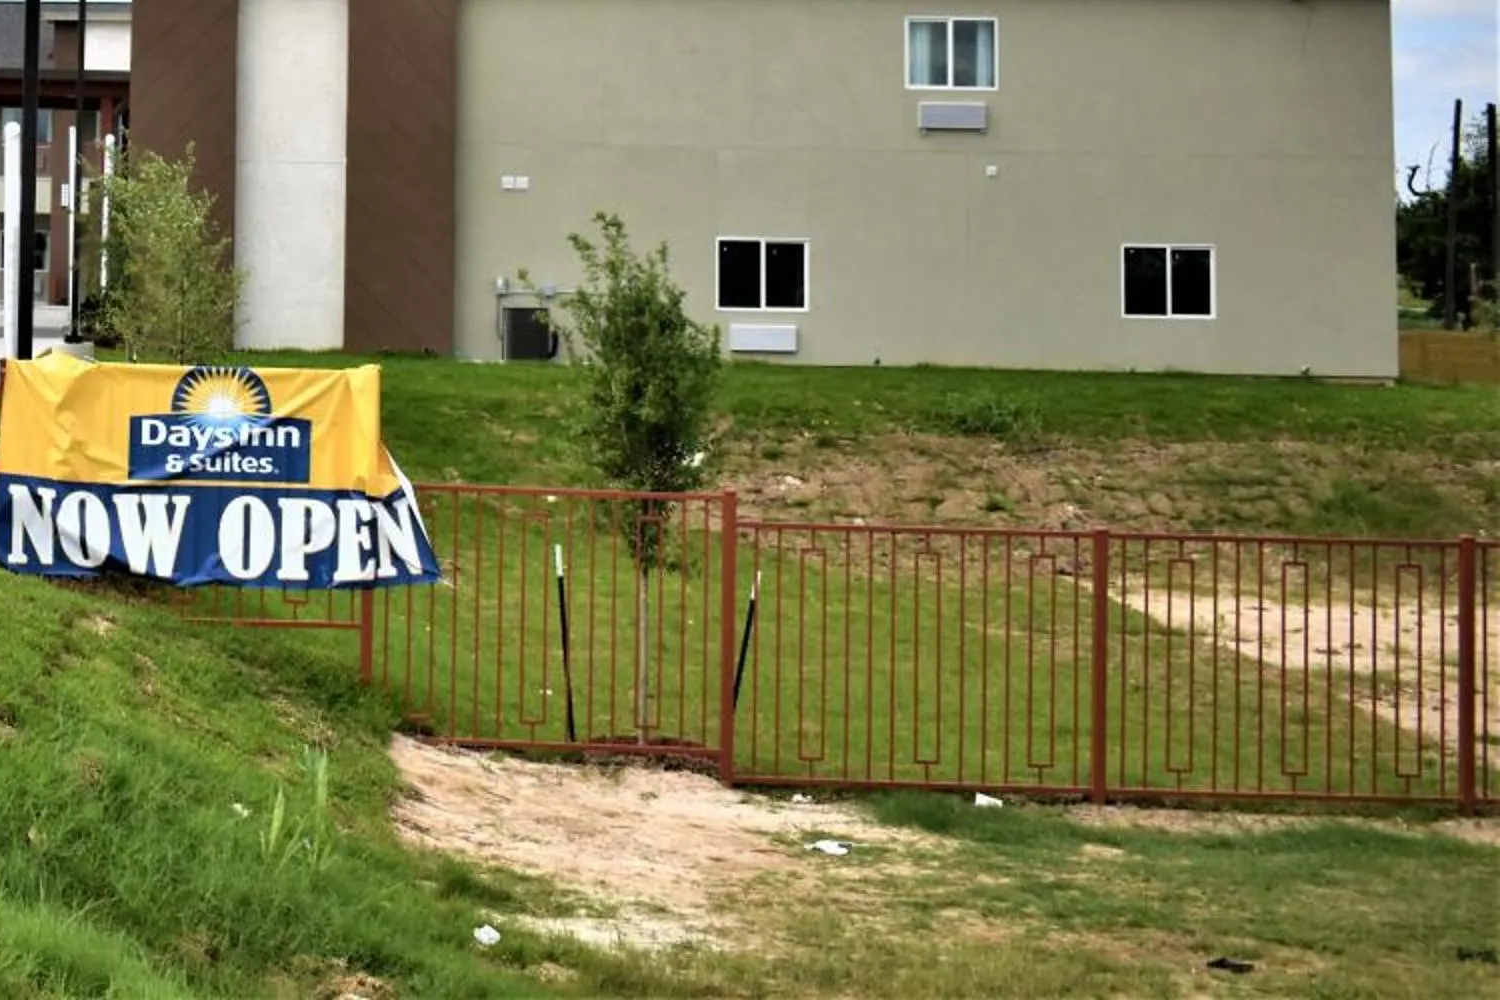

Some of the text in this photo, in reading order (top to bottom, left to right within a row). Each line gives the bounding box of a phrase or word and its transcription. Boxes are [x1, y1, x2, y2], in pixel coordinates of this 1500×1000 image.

[141, 418, 301, 453] Days Inn
[164, 453, 184, 472] &
[7, 483, 424, 582] NOW OPEN
